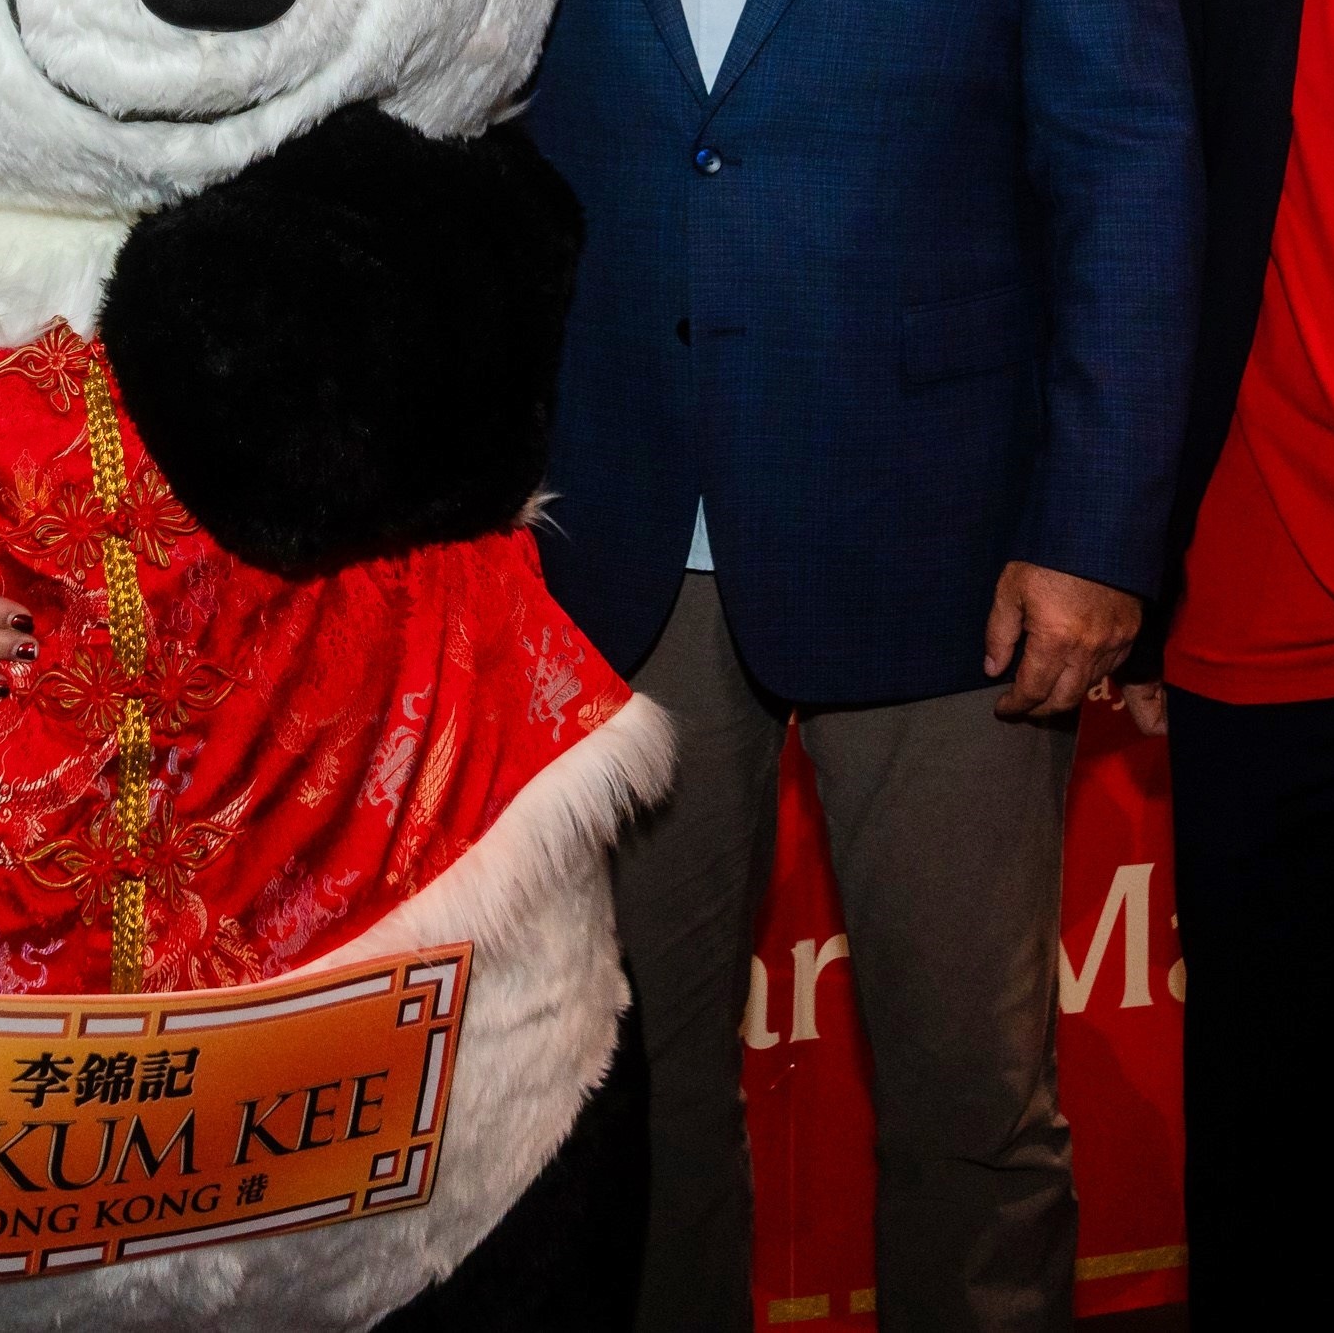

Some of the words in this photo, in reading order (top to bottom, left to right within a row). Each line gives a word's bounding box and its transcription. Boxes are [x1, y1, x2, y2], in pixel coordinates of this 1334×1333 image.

[8, 1046, 201, 1109] 李錦記
[231, 1068, 390, 1167] KEE
[92, 1183, 222, 1230] KONG
[236, 1173, 269, 1207] 港
